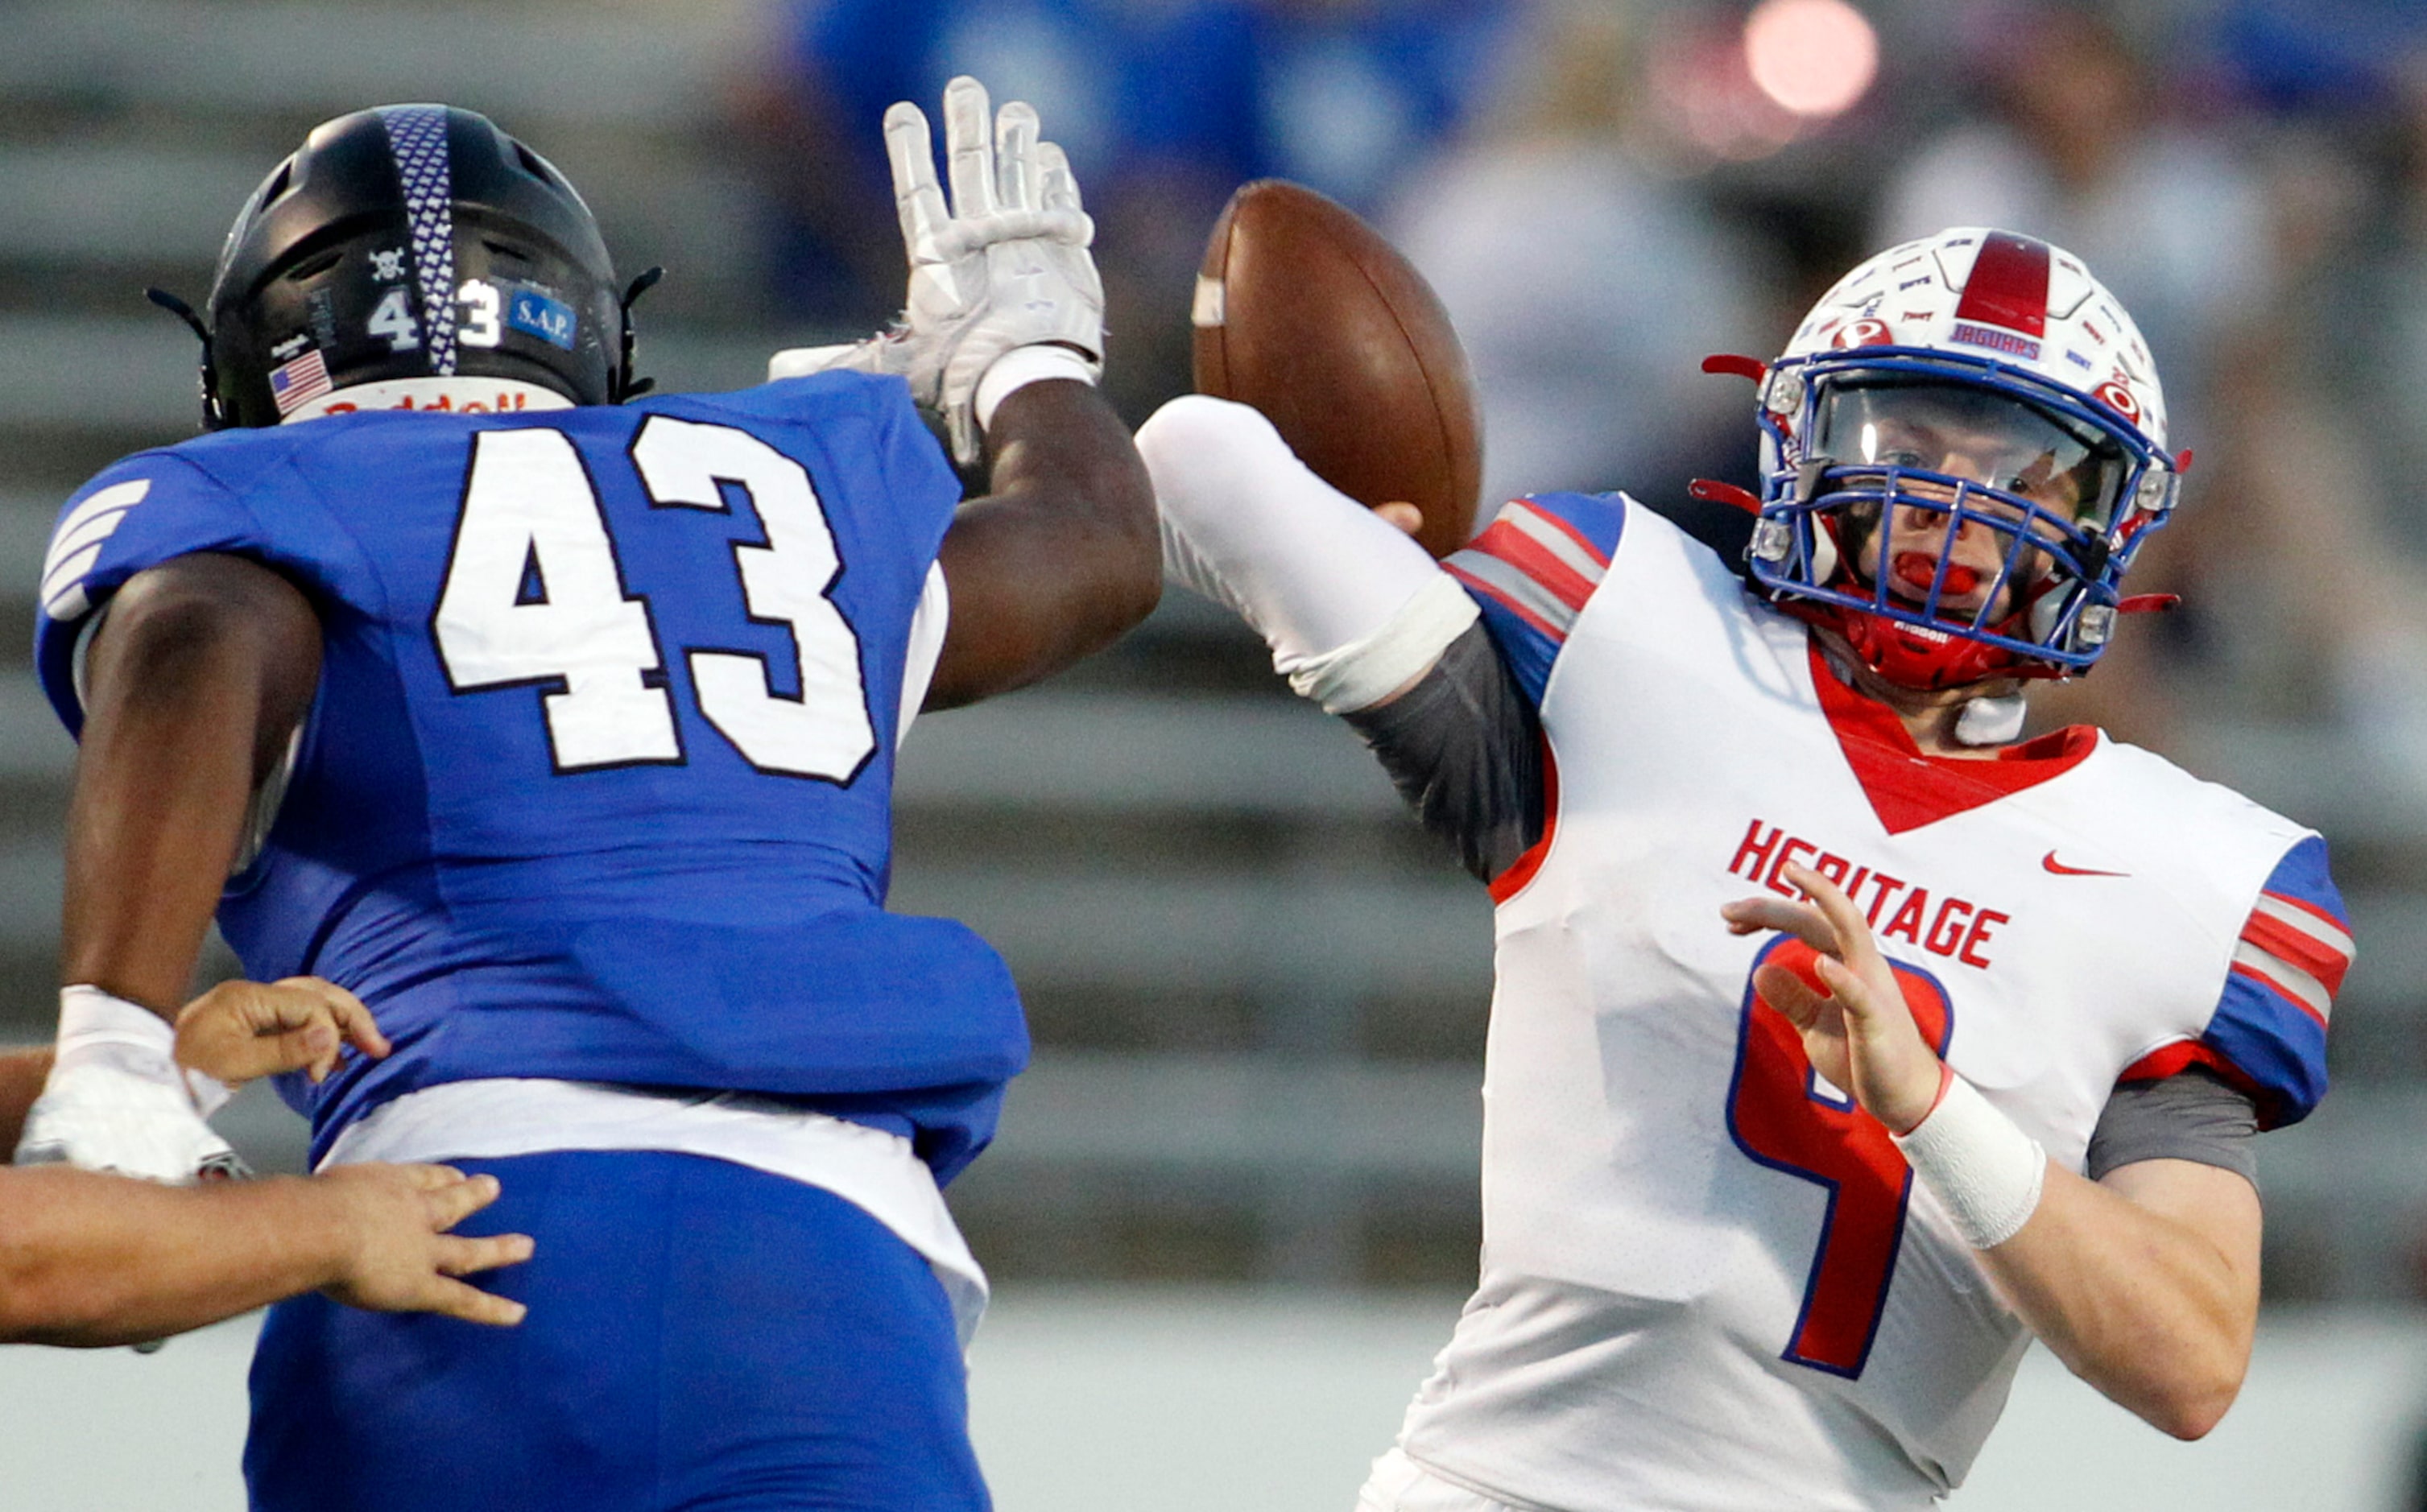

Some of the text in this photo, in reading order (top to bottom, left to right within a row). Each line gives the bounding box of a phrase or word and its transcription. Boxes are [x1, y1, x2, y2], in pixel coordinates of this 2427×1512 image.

[518, 300, 568, 339] S.A.P.
[1949, 323, 2040, 360] JAGUARS
[430, 414, 878, 789] 43
[1725, 932, 1954, 1380] 9
